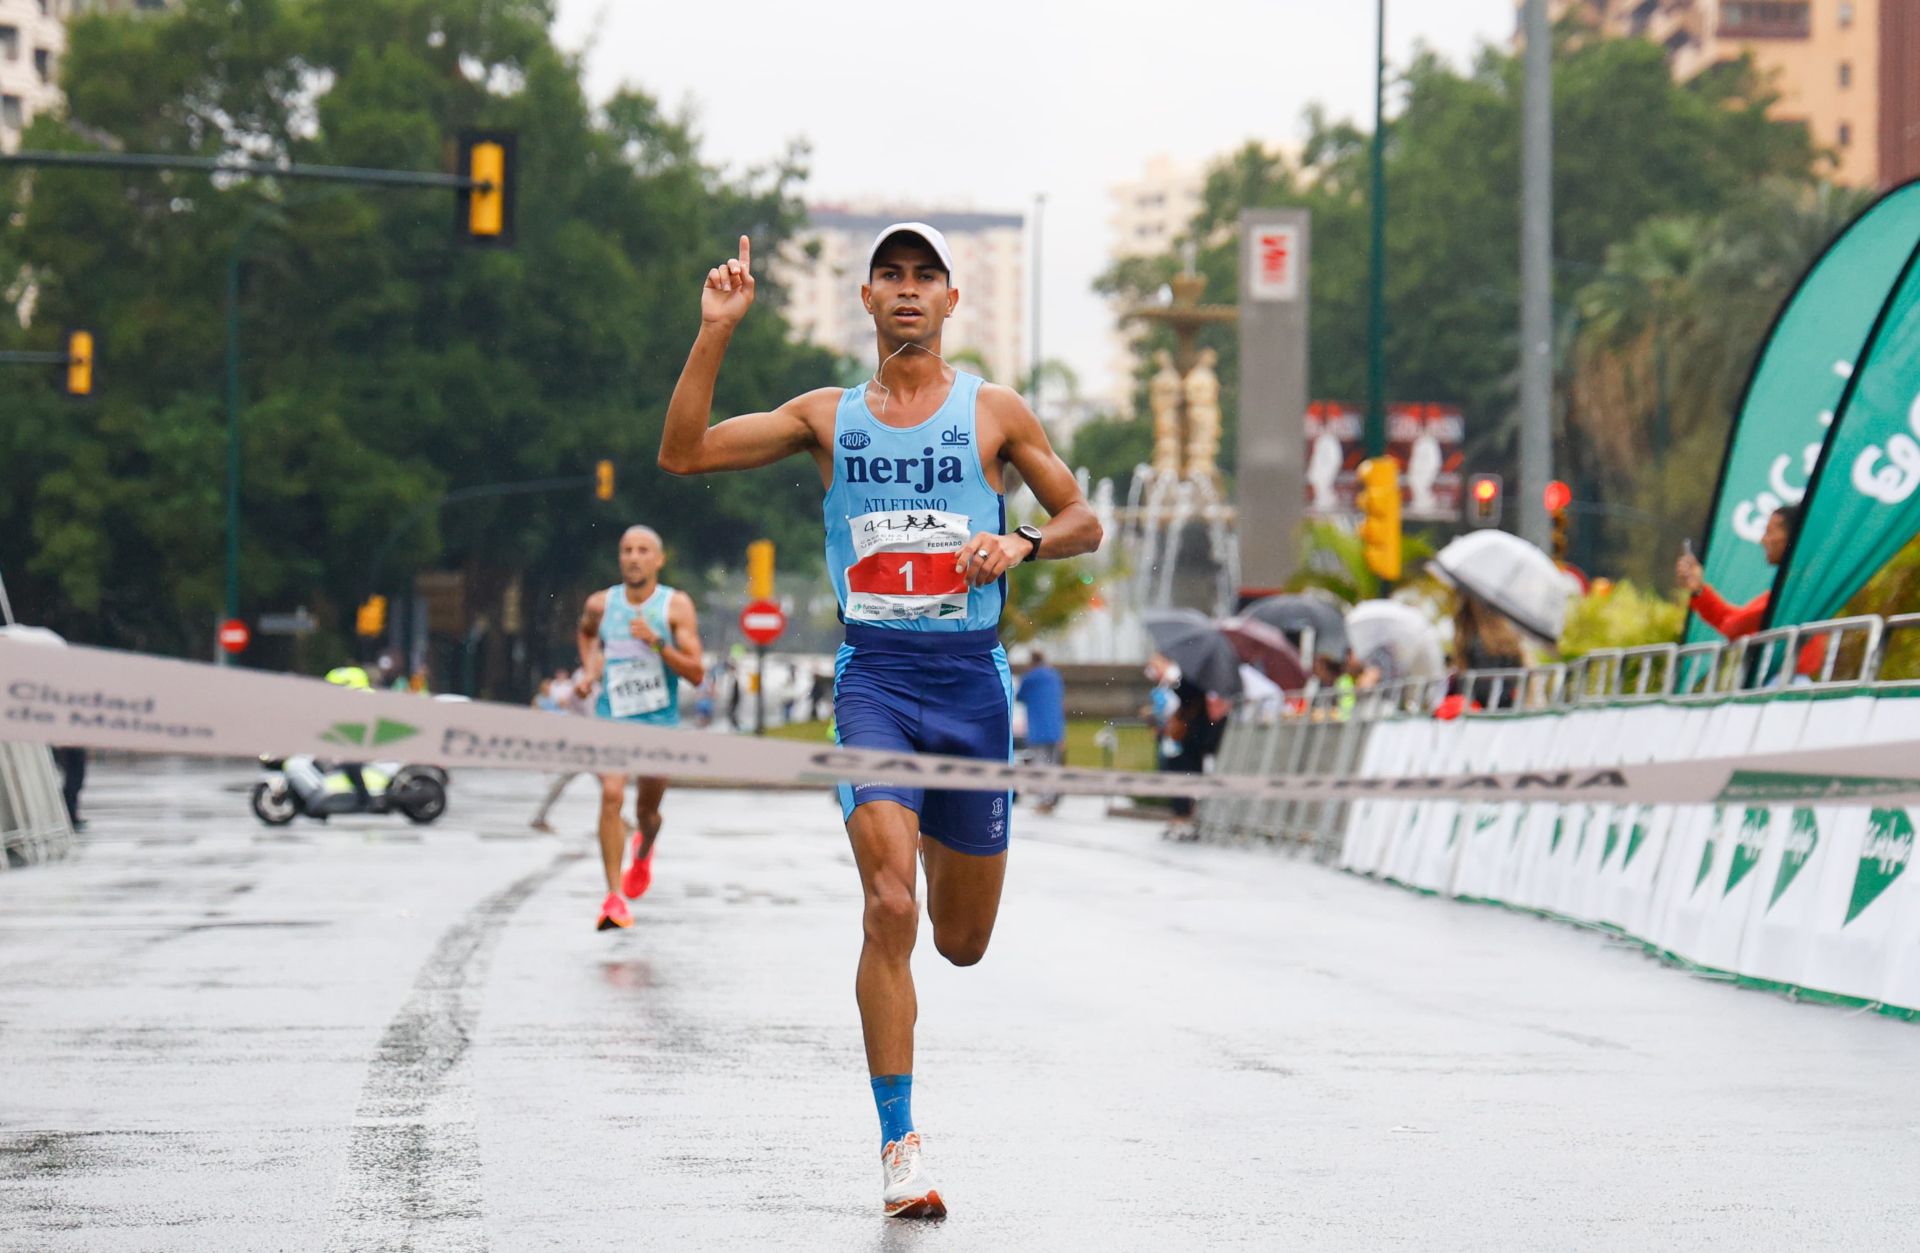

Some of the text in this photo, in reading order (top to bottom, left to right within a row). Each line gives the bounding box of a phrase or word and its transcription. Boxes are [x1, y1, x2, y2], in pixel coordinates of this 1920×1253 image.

[841, 432, 870, 449] TROPS
[942, 424, 970, 445] als
[844, 446, 964, 494] nerja
[864, 497, 948, 513] ATLETISMO
[927, 540, 963, 549] FEDERADO
[898, 560, 914, 592] 1
[7, 679, 155, 714] Ciudad
[5, 705, 55, 724] de
